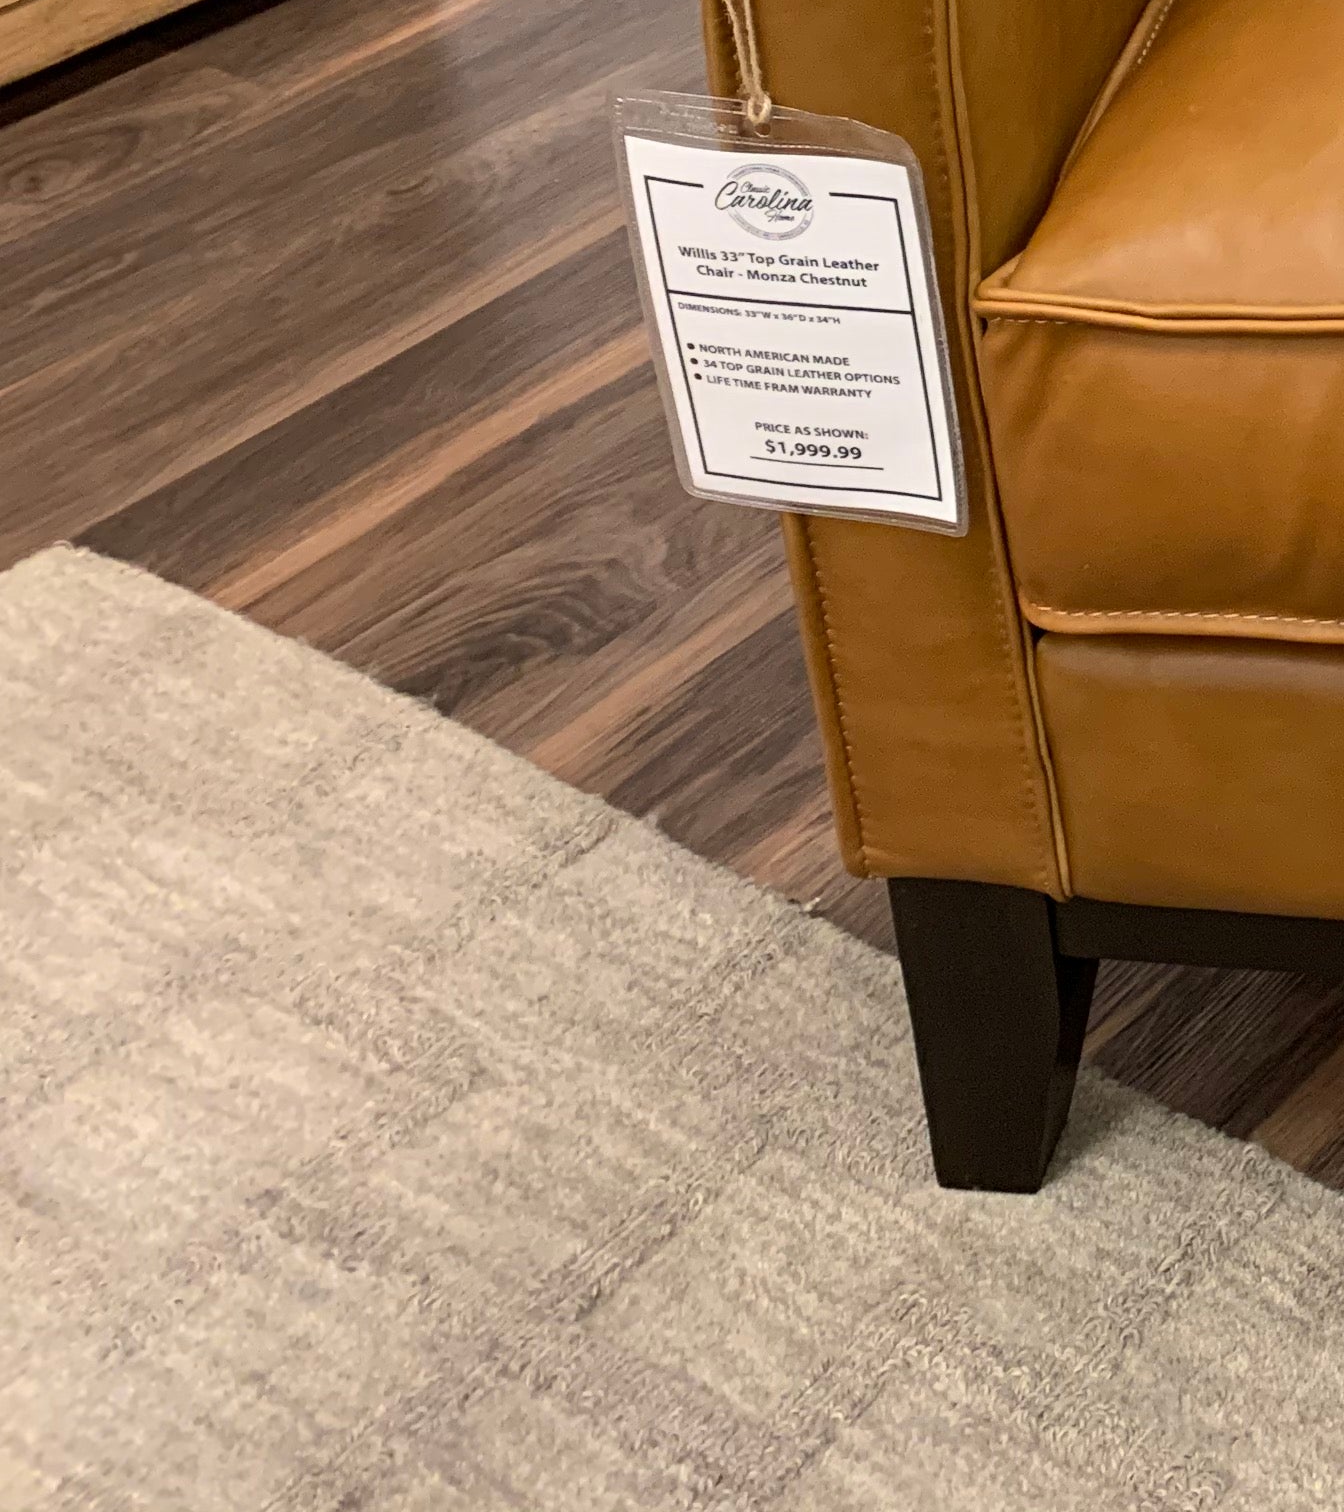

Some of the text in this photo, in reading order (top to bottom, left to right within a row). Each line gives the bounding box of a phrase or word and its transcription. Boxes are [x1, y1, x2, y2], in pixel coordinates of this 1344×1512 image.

[714, 180, 814, 211] Carolina
[678, 245, 717, 260] Willis
[746, 252, 775, 267] Top
[778, 254, 819, 268] Grain
[822, 257, 879, 271] Leather
[696, 264, 734, 278] Chair
[746, 269, 796, 283] Monza
[799, 272, 867, 287] Chestnut
[699, 343, 851, 367] NORTH AMERICAN MADE
[703, 359, 901, 386] 34 TOP GRAIN LEATHER OPTIONS
[706, 374, 731, 386] LIFE
[764, 381, 800, 394] FRAM
[801, 385, 872, 399] WARRANTY
[754, 421, 869, 440] PRICE AS SHOWN:
[764, 438, 863, 460] $1,999.99
